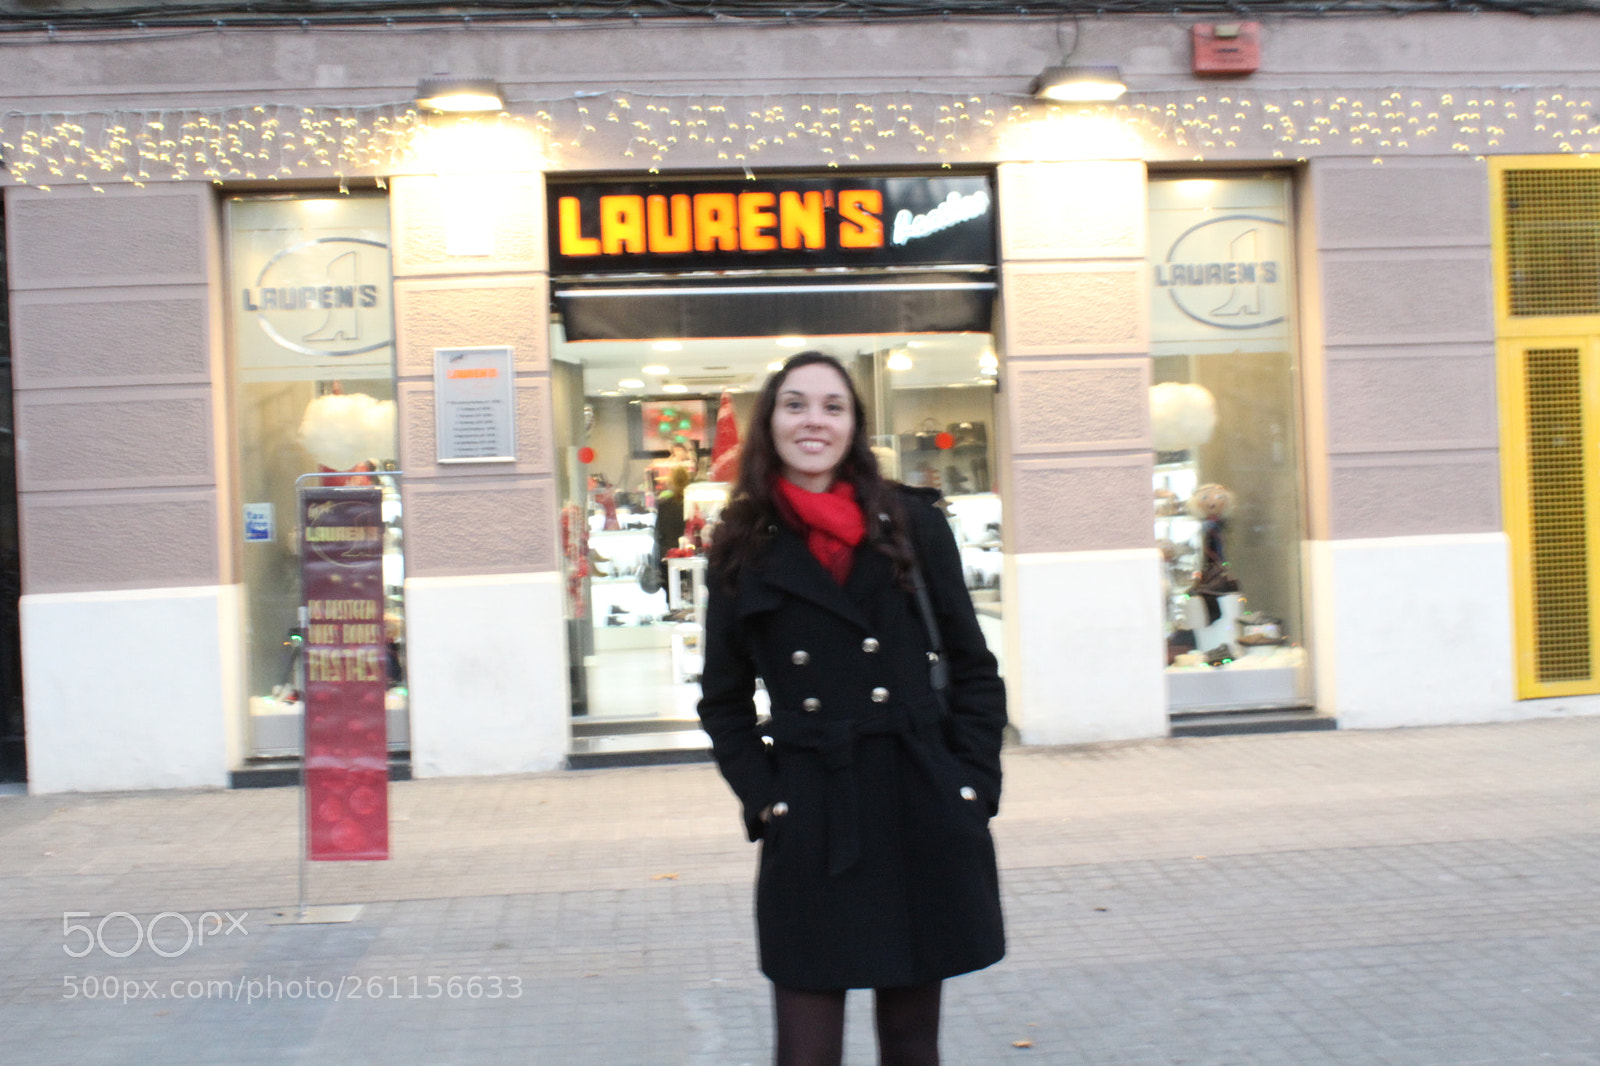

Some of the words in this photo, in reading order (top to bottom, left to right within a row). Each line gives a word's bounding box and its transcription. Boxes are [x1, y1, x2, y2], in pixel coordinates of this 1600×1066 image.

[558, 189, 885, 257] LAUREN'S
[1154, 262, 1277, 287] LAUREN'S
[242, 285, 377, 311] LAUREN'S
